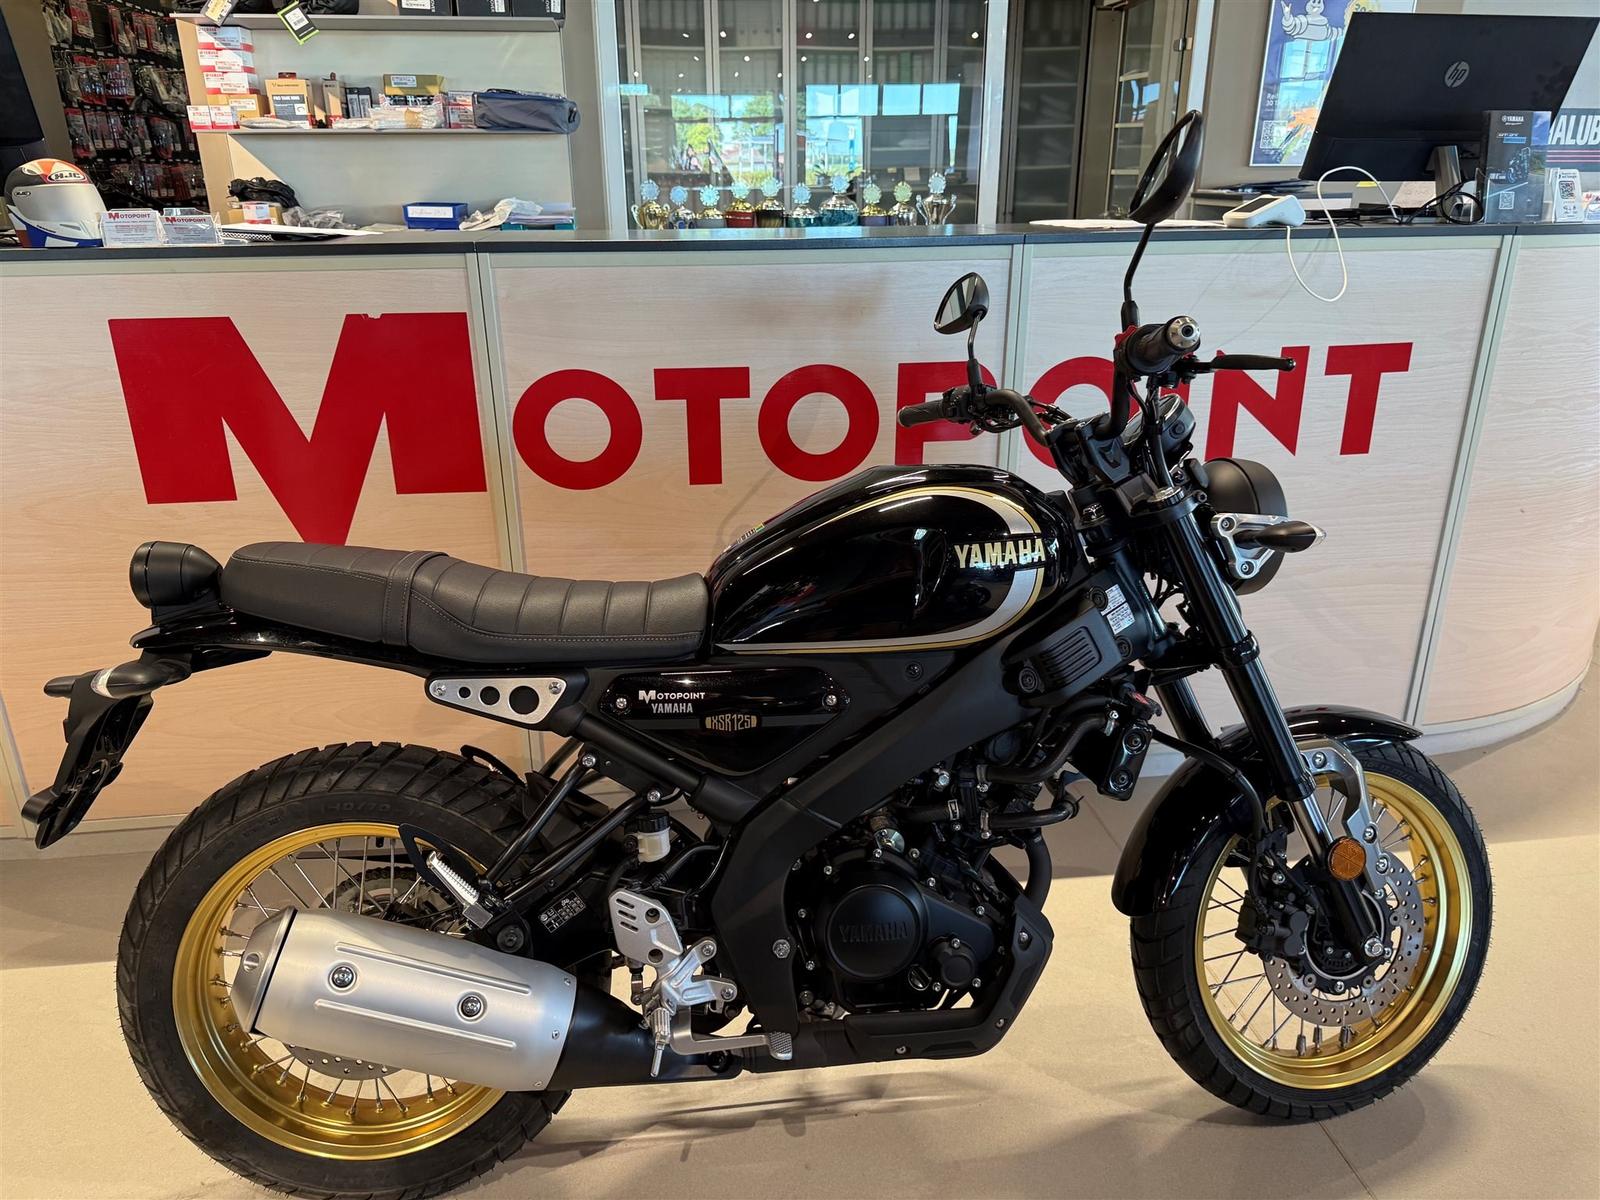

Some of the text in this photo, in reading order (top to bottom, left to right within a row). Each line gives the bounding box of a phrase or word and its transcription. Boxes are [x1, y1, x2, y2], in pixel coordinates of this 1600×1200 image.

[1445, 61, 1470, 88] hp
[54, 172, 81, 180] HJC
[108, 212, 151, 220] MOTOPOINT
[108, 312, 1413, 546] MOTOPONT
[954, 538, 1046, 569] YAMAHA
[638, 690, 706, 704] MOTOPOINT
[651, 702, 693, 714] YAMAHA
[711, 713, 751, 732] XSR125
[838, 921, 910, 943] YAMAHA
